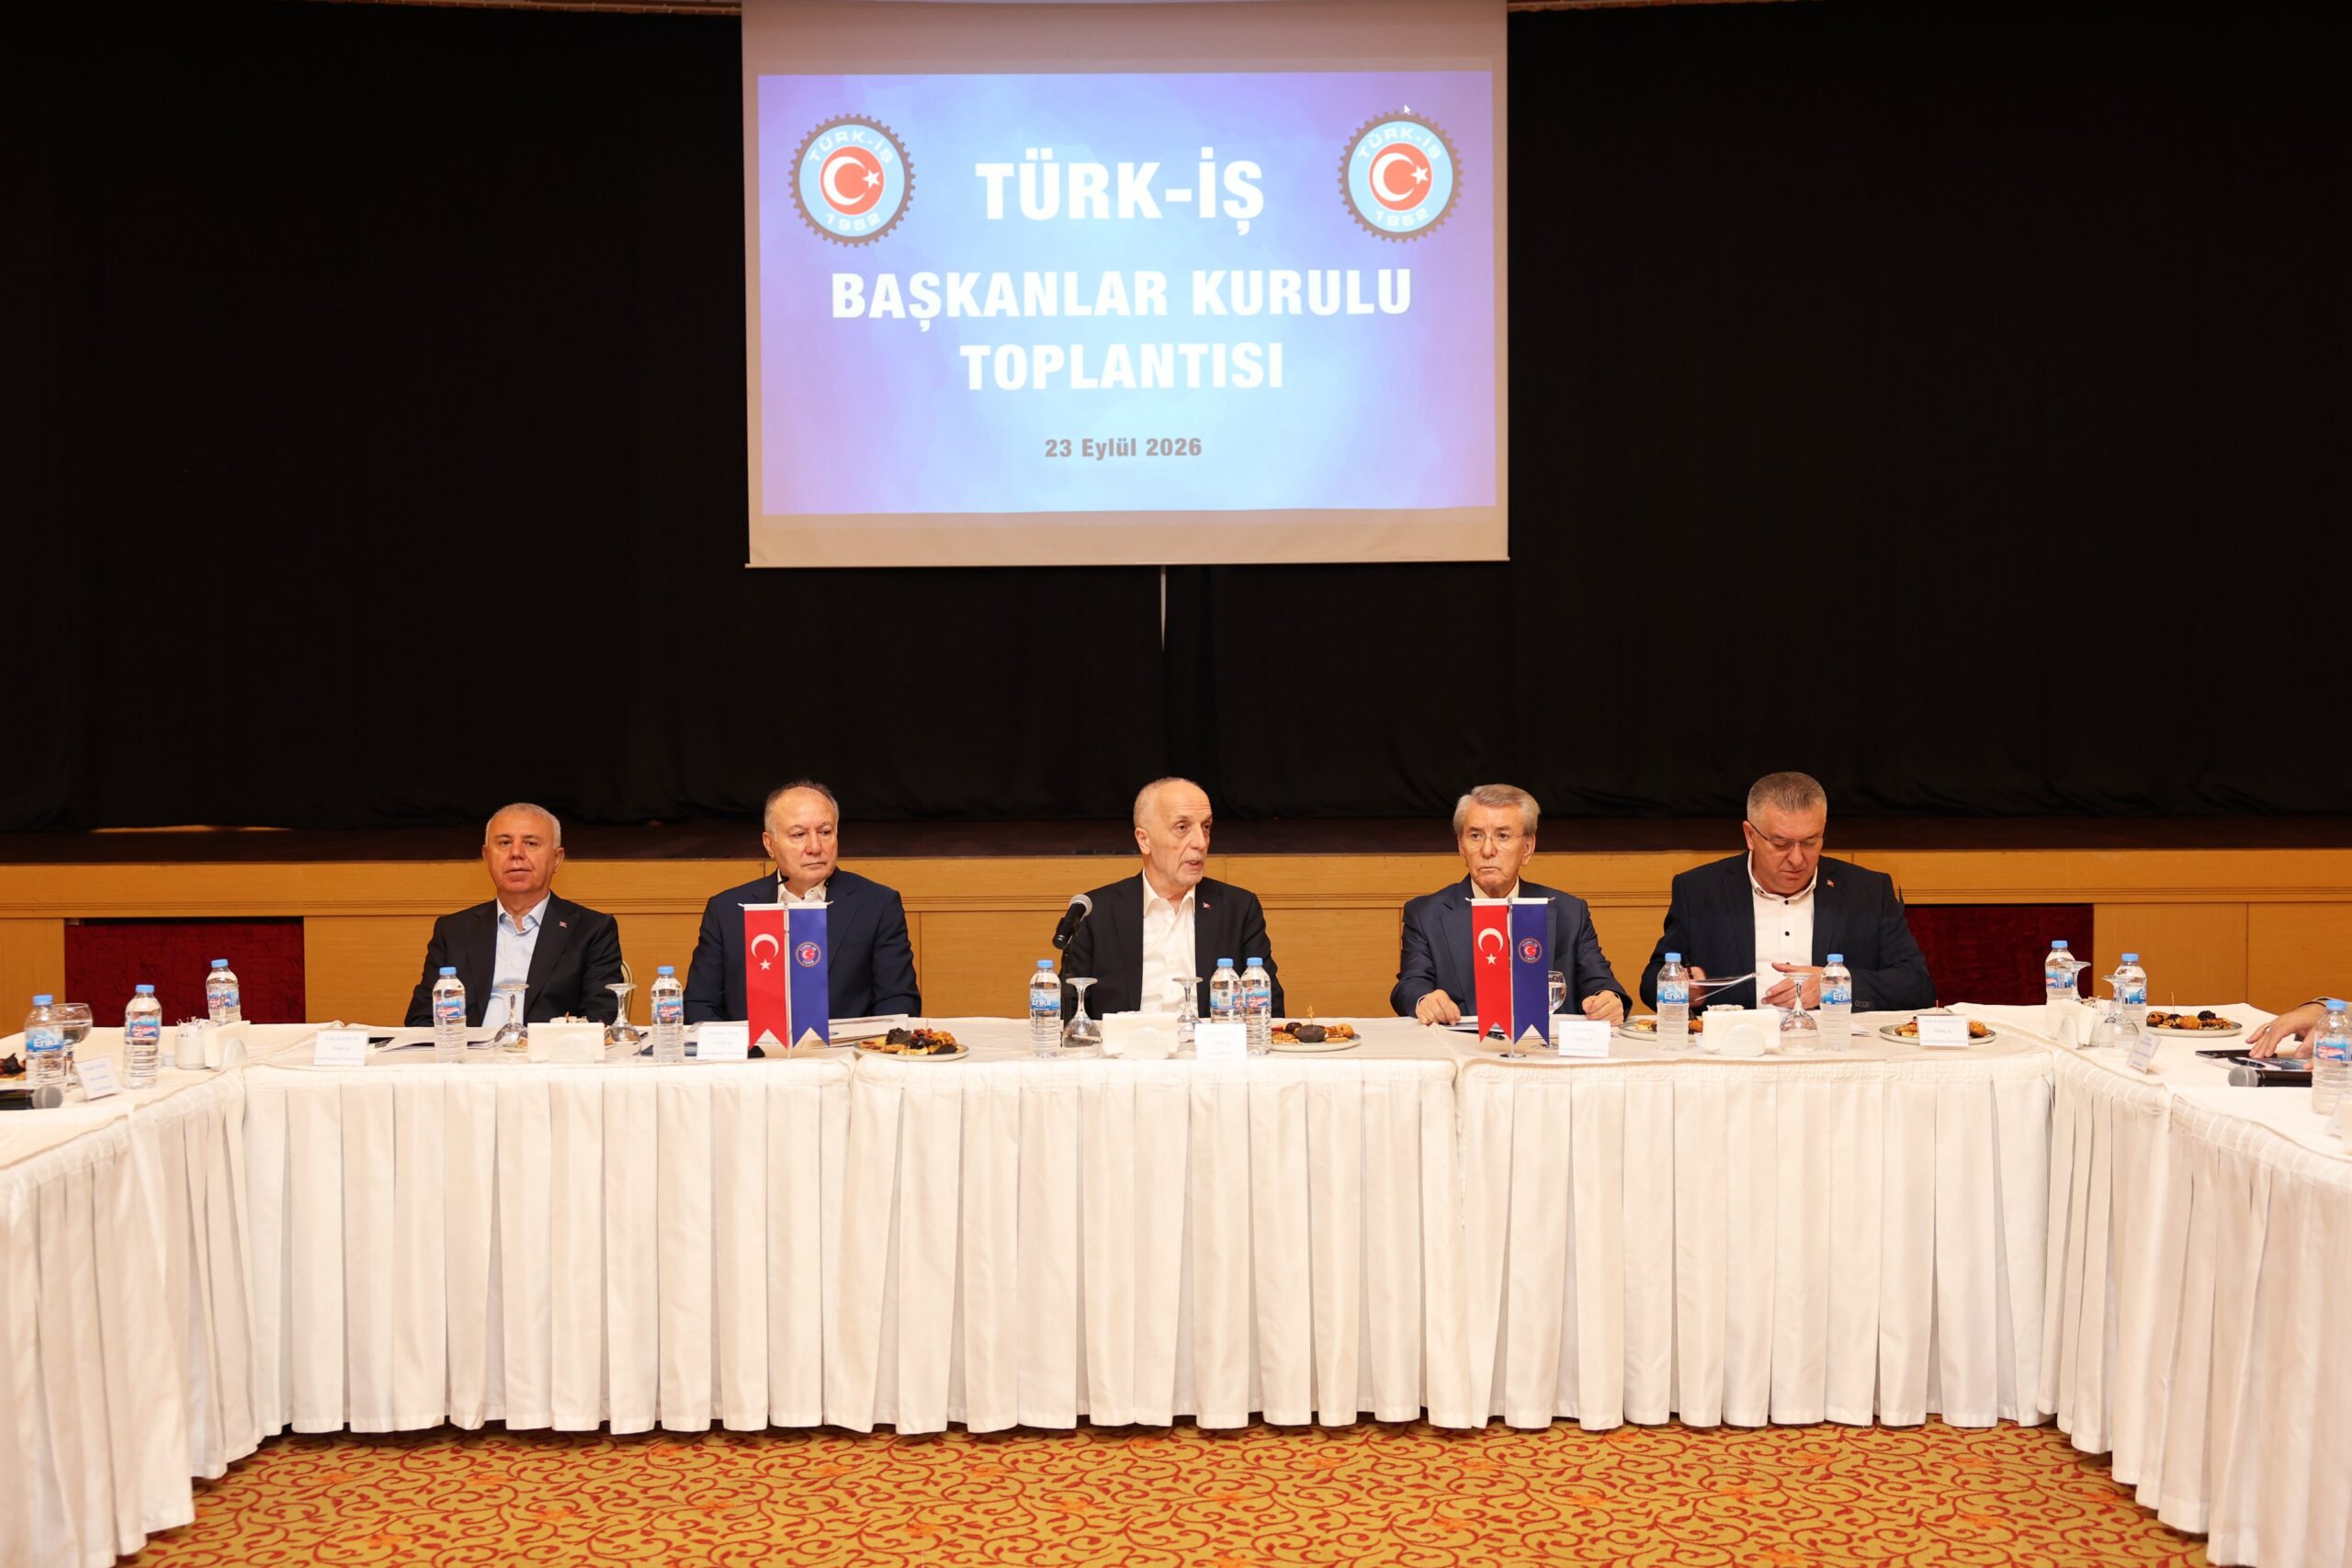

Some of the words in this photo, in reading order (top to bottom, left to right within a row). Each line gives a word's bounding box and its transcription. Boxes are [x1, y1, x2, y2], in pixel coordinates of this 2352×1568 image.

[976, 147, 1264, 236] TÜRK-İŞ
[826, 211, 881, 231] 1952
[1374, 207, 1430, 228] 1952
[832, 270, 1168, 333] BAŞKANLAR
[1193, 268, 1410, 317] KURULU
[959, 342, 1283, 390] TOPLANTISI
[1045, 439, 1072, 457] 23
[1081, 437, 1136, 461] Eylül
[1146, 437, 1202, 457] 2026
